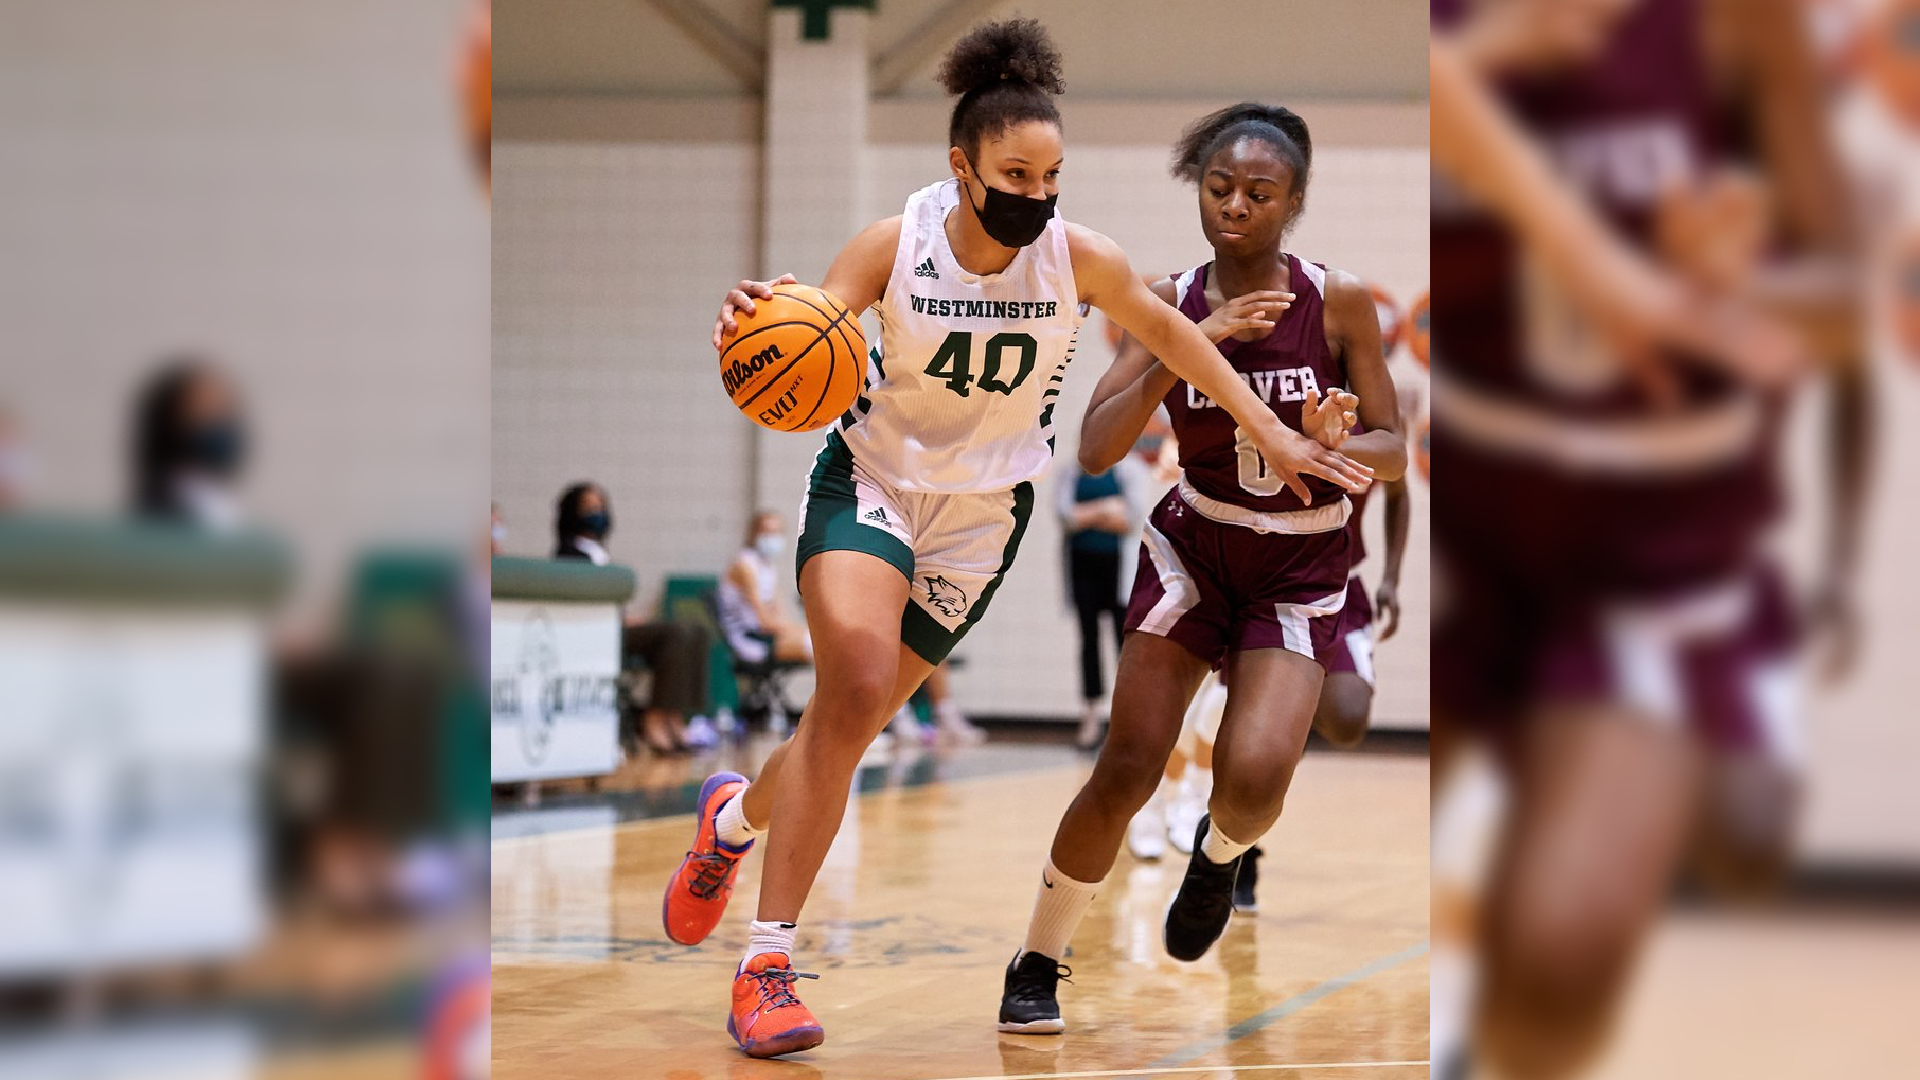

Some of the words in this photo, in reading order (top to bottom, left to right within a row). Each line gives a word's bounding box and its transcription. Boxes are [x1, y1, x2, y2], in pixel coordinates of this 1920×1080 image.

[910, 294, 1057, 319] WESTMINSTER
[923, 331, 1038, 397] 40
[1187, 366, 1322, 409] CVER
